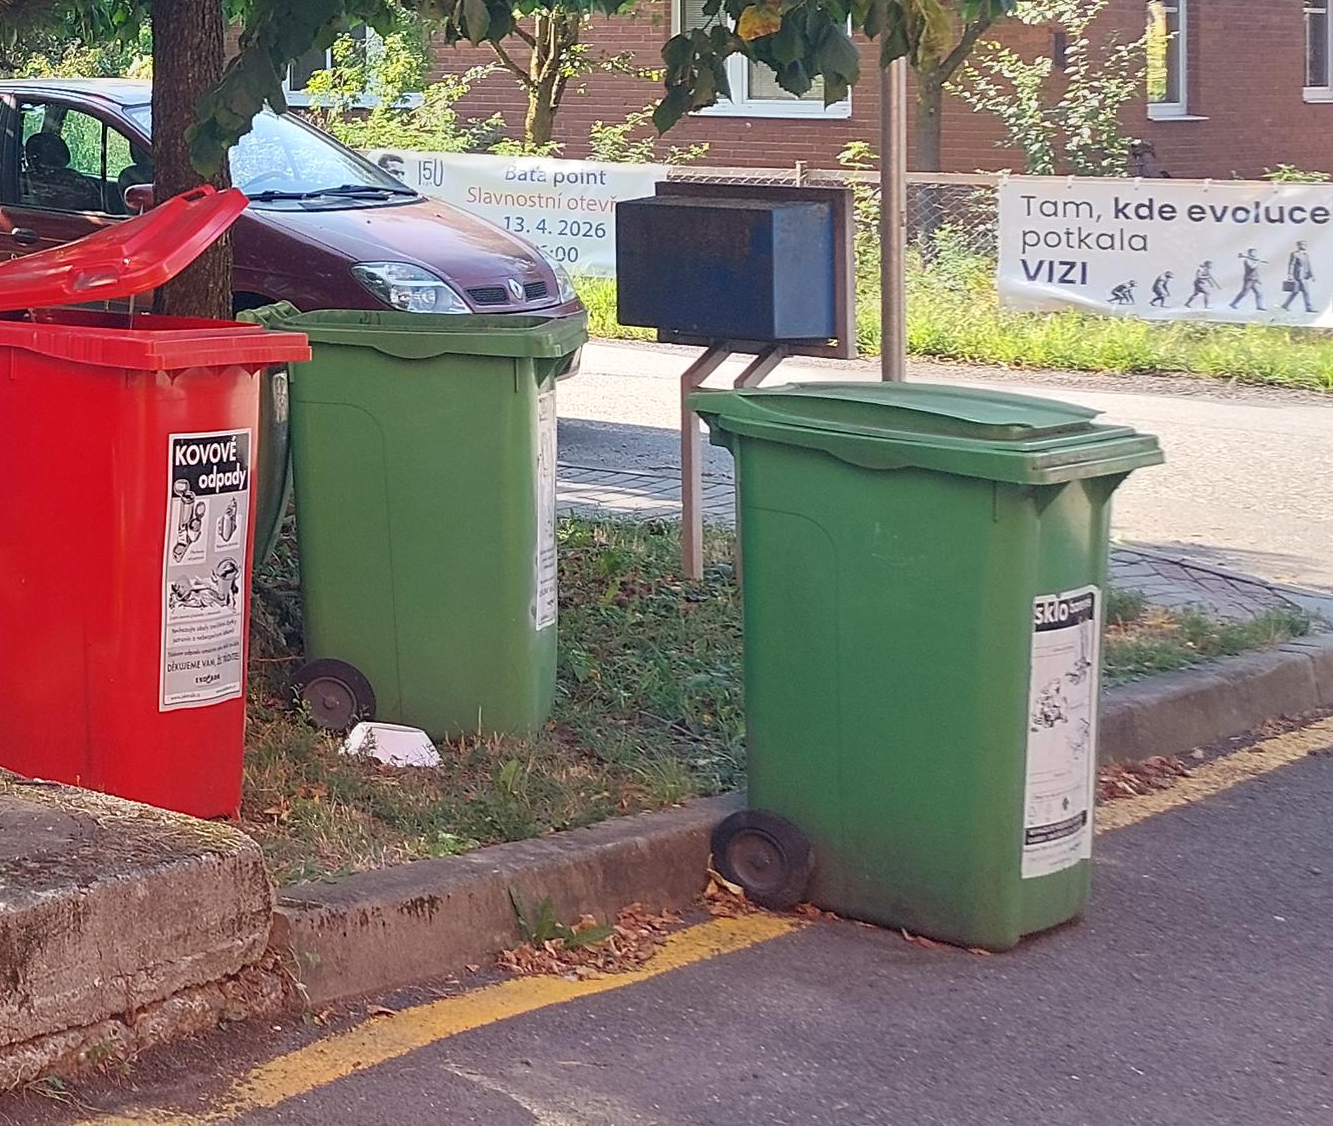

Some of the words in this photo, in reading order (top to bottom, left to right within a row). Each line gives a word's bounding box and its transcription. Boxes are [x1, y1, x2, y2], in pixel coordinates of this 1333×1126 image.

[504, 164, 547, 183] Baťa
[553, 169, 607, 187] point
[466, 186, 562, 209] Slavnostní
[1020, 195, 1102, 222] Tam,
[1114, 196, 1176, 222] kde
[1187, 201, 1330, 224] evoluce
[504, 216, 530, 233] 13.
[535, 218, 552, 235] 4.
[557, 219, 606, 238] 2026
[1021, 226, 1148, 254] potkala
[1020, 259, 1088, 285] VIZI
[175, 435, 237, 466] KOVOVÉ
[198, 462, 247, 493] odpady
[1034, 601, 1069, 625] sklo
[167, 660, 201, 672] DĚKUJEME
